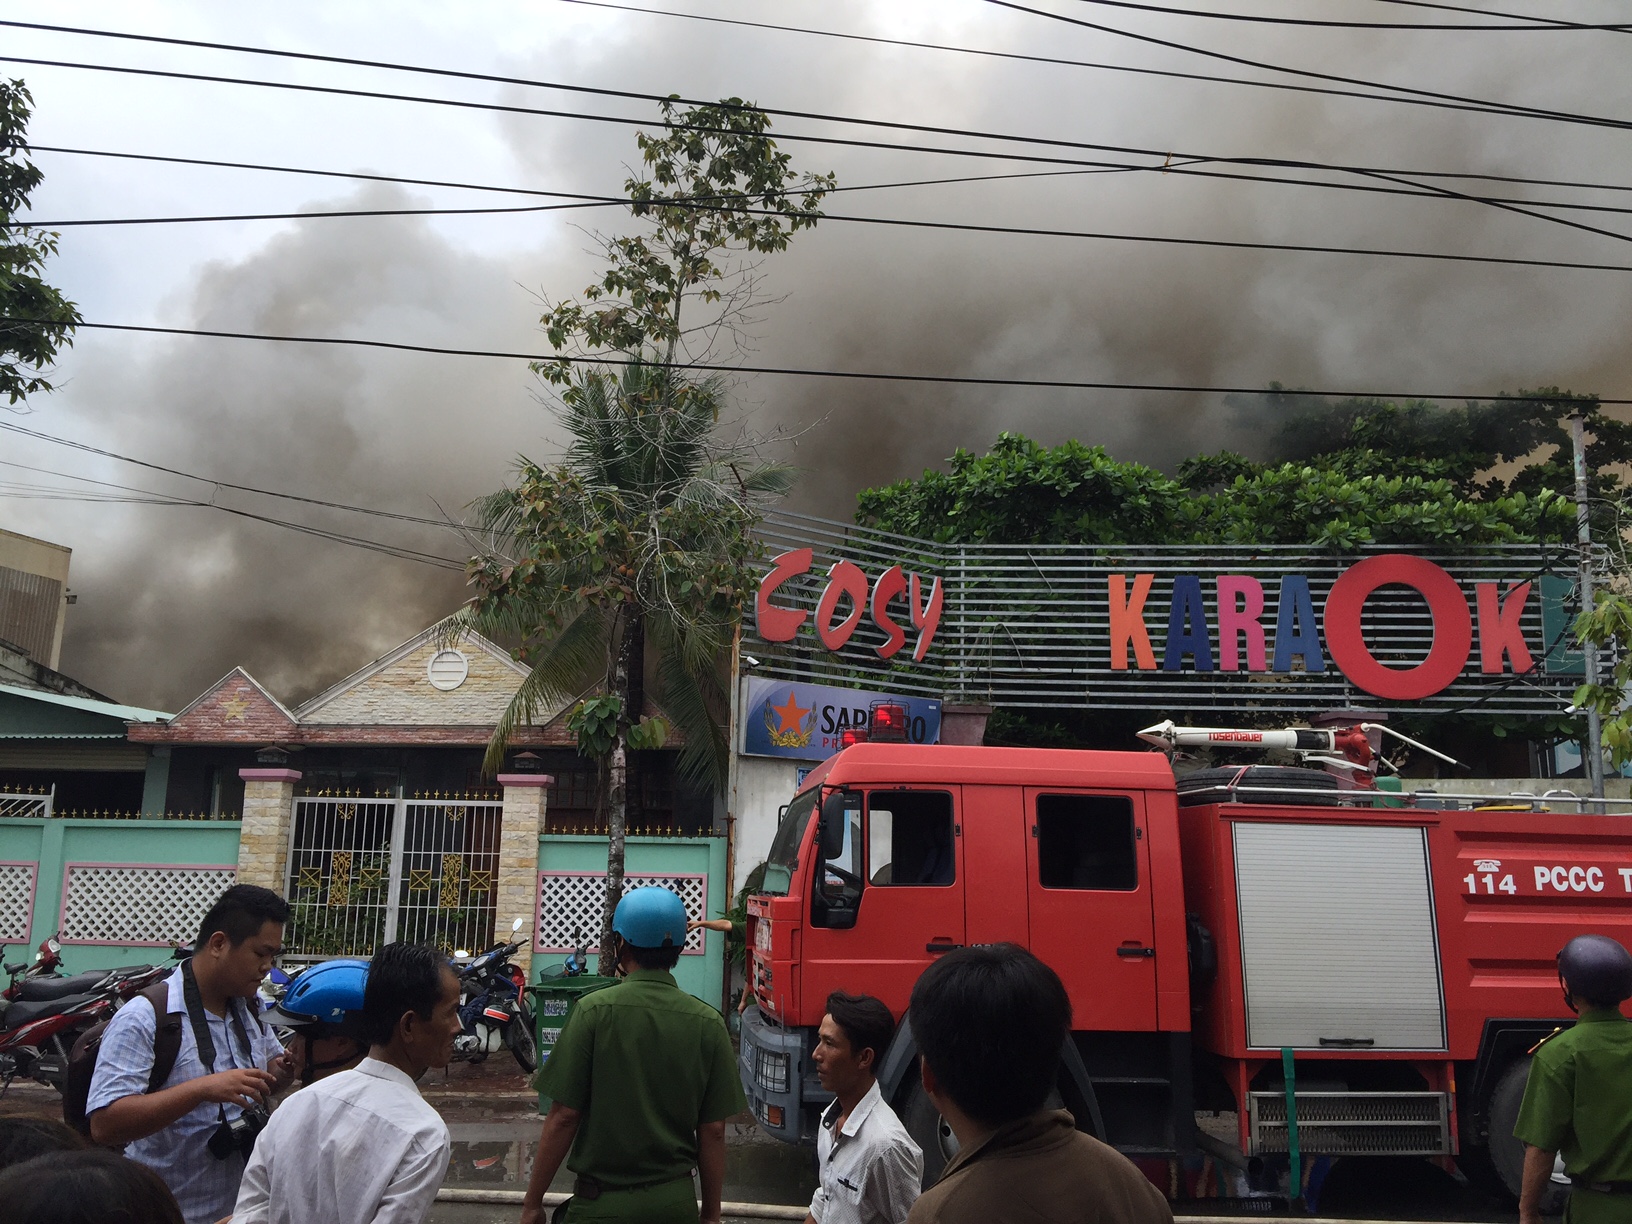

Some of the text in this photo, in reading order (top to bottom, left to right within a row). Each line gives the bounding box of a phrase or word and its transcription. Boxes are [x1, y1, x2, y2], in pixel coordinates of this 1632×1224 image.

[755, 547, 944, 663] COSY
[1107, 553, 1588, 699] KARAOKE
[1463, 873, 1517, 895] 114
[1533, 865, 1605, 893] PCCC
